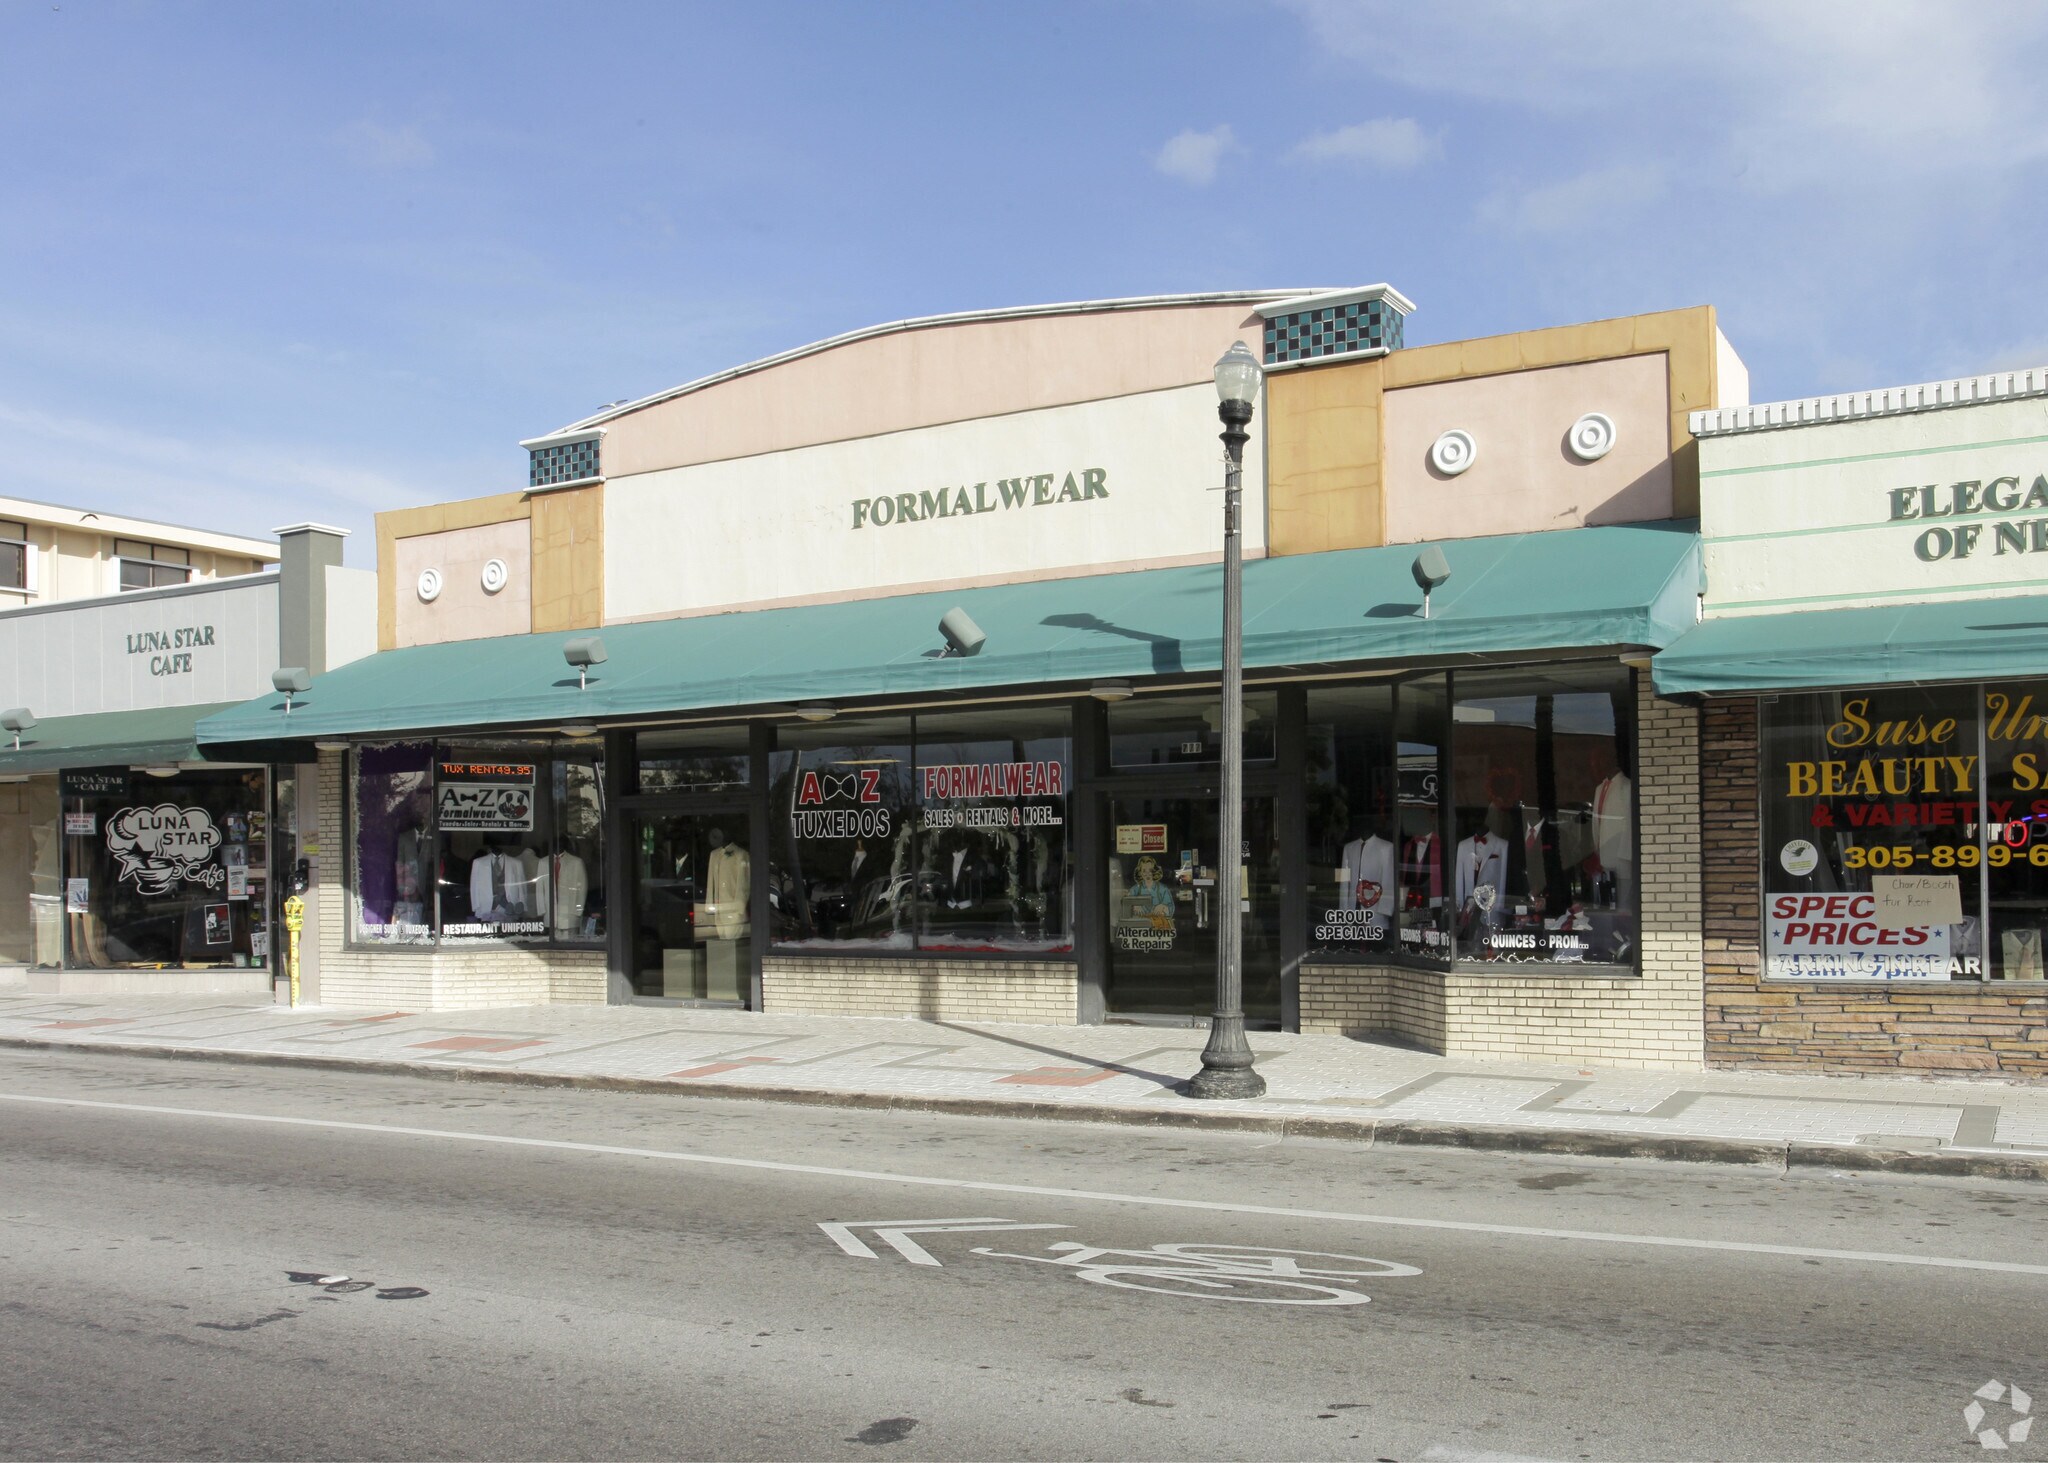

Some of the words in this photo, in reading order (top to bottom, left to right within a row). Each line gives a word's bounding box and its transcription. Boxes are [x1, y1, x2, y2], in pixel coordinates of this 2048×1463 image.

[851, 467, 1110, 530] FORMALWEAR
[1914, 524, 1982, 562] OF
[126, 630, 171, 654] LUNA
[174, 625, 215, 649] STAR
[150, 652, 192, 676] CAFE
[1826, 698, 1956, 748] Suse
[443, 764, 464, 773] TUX
[1786, 755, 1977, 797] BEAUTY
[2012, 752, 2048, 791] S
[67, 775, 94, 783] LUNA
[80, 783, 108, 791] CAFE
[799, 771, 823, 804] A
[860, 769, 880, 803] Z
[924, 761, 1062, 799] FORMALWEAR
[478, 789, 494, 807] Z
[440, 806, 497, 818] Formalwear
[925, 808, 954, 827] SALES
[966, 807, 1008, 826] RENTALS
[1012, 806, 1020, 826] &
[1810, 804, 1833, 827] &
[1845, 801, 2014, 828] VARIETY
[138, 816, 191, 830] LUNA
[791, 808, 890, 838] TUXEDOS
[162, 831, 212, 845] STAR
[1143, 832, 1164, 845] Closed
[183, 863, 226, 888] Cafe
[1772, 895, 1876, 919] SPEC
[1325, 909, 1374, 925] GROUP
[405, 924, 430, 935] TUXEDOS
[443, 924, 498, 935] RESTAURANT
[502, 922, 545, 933] UNIFORMS
[1117, 927, 1176, 938] Alterations
[1315, 925, 1384, 940] SPECIALS
[1783, 922, 1929, 946] PRICES
[1122, 938, 1131, 949] &
[1132, 938, 1171, 951] Repairs
[1491, 934, 1536, 949] QUINCES
[1767, 955, 1878, 974] PARKING
[1885, 955, 1906, 973] IN
[1912, 956, 1982, 974] REAR
